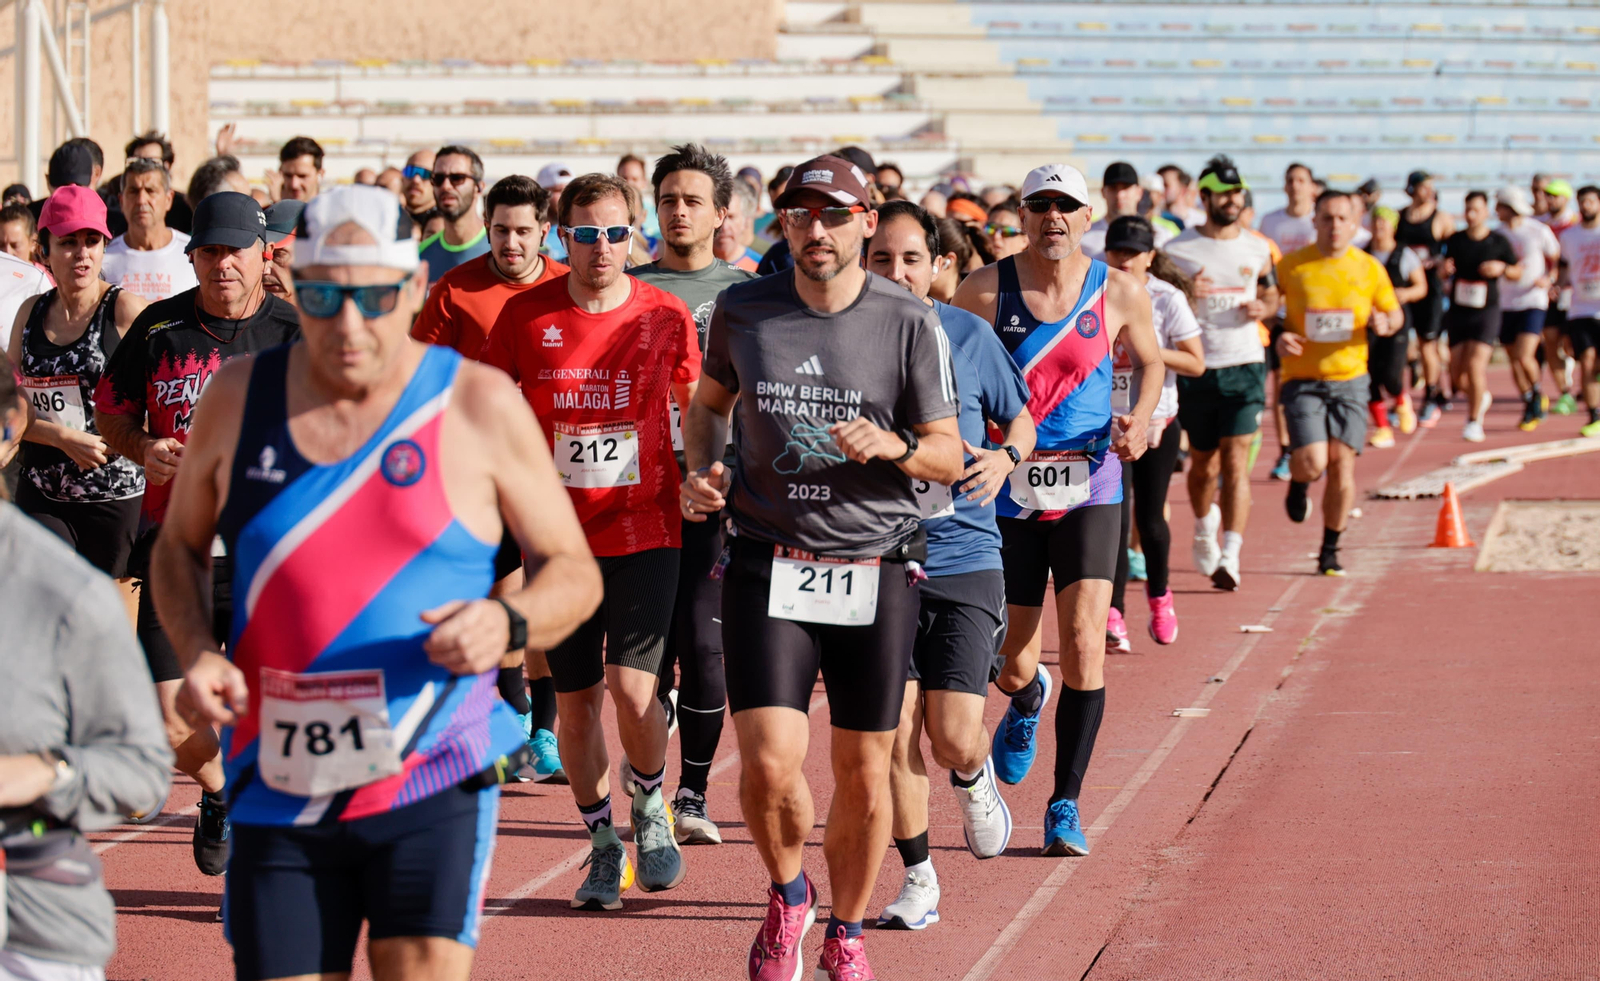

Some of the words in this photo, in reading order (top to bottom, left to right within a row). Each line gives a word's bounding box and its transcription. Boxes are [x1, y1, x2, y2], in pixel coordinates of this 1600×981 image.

[1208, 296, 1235, 310] 307
[552, 369, 610, 380] GENERALI
[579, 384, 609, 393] MARATÓN
[756, 381, 796, 398] BMW
[800, 385, 862, 405] BERLIN
[32, 391, 66, 412] 496
[553, 389, 611, 410] MÁLAGA
[757, 398, 861, 421] MARATHON
[555, 422, 580, 435] XXXVI
[569, 438, 619, 464] 212
[1027, 465, 1070, 488] 601
[787, 483, 831, 501] 2023
[798, 566, 853, 596] 211
[274, 715, 365, 758] 781
